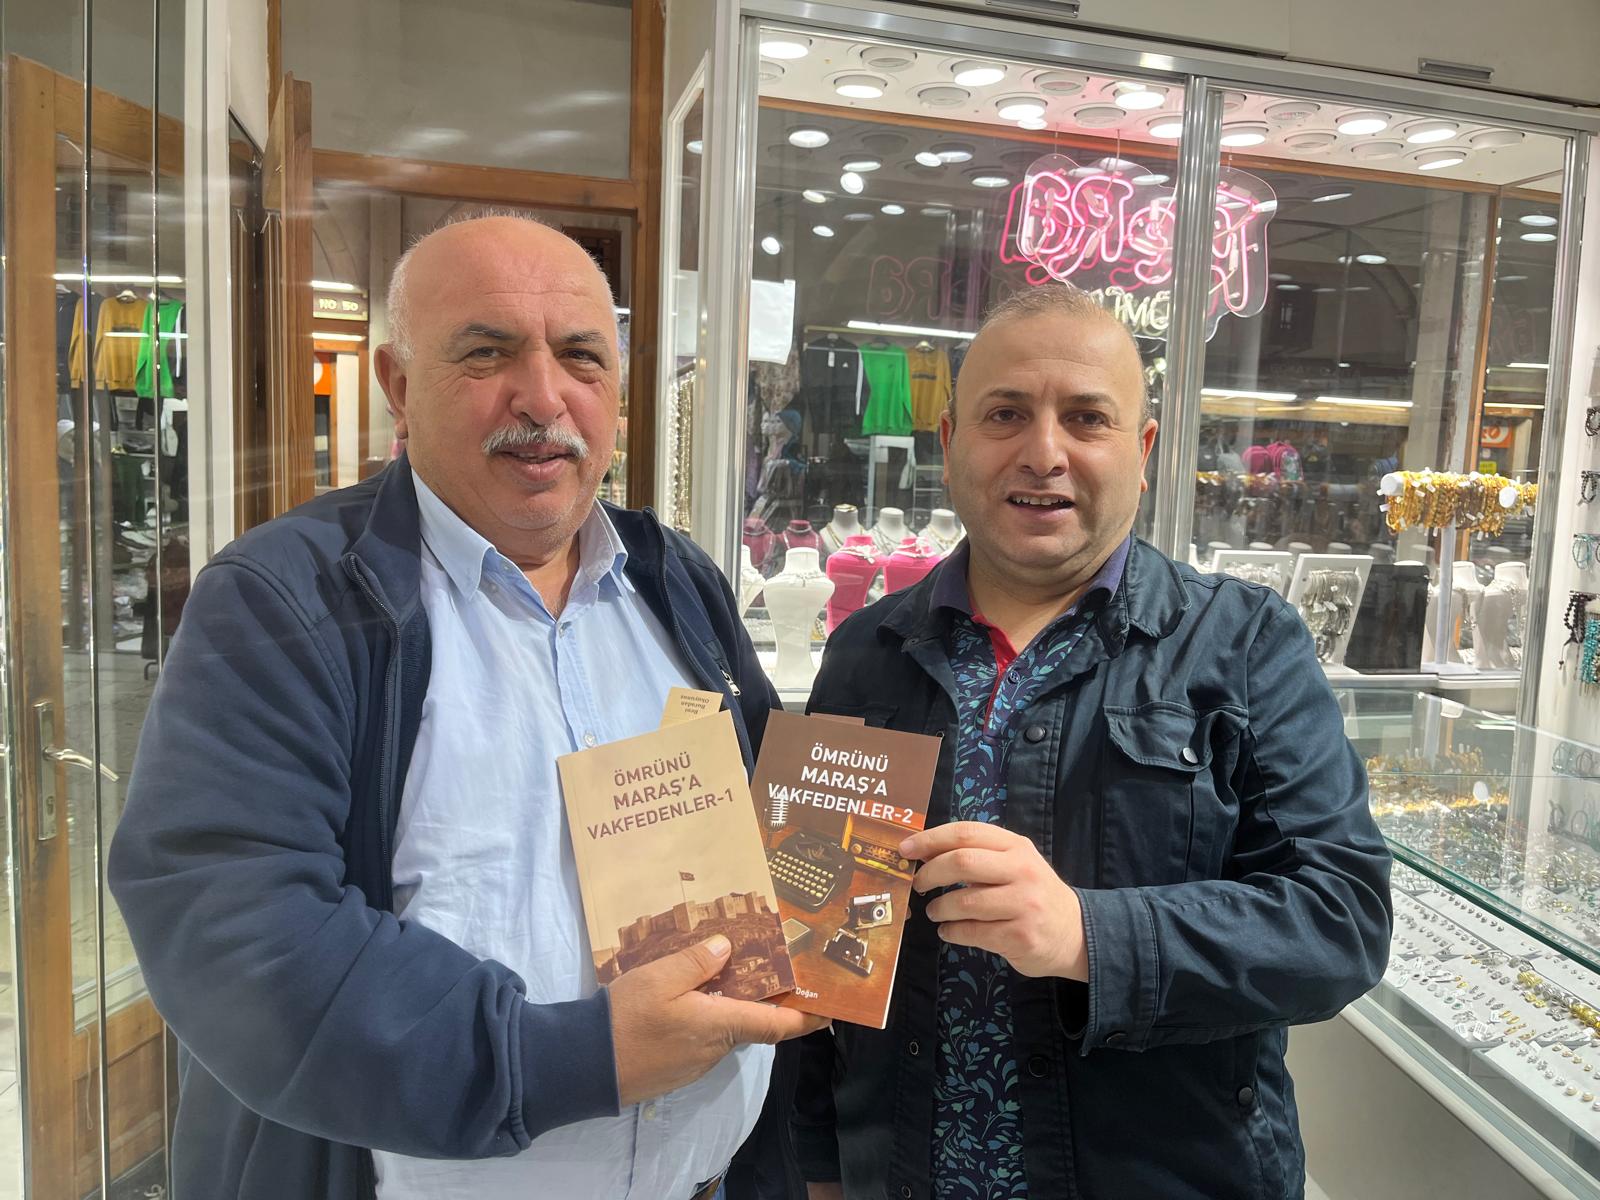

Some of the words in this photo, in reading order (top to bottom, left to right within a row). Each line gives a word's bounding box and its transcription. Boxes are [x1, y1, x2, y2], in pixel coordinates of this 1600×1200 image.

[319, 298, 337, 310] NO
[613, 751, 692, 787] ÖMRÜNÜ
[810, 742, 889, 773] ÖMRÜNÜ
[613, 774, 702, 810] MARAŞ'A
[800, 765, 888, 797] MARAŞ'A
[587, 787, 734, 840] VAKFEDENLER-1
[768, 782, 914, 824] VAKFEDENLER-2
[795, 987, 819, 999] Doğan
